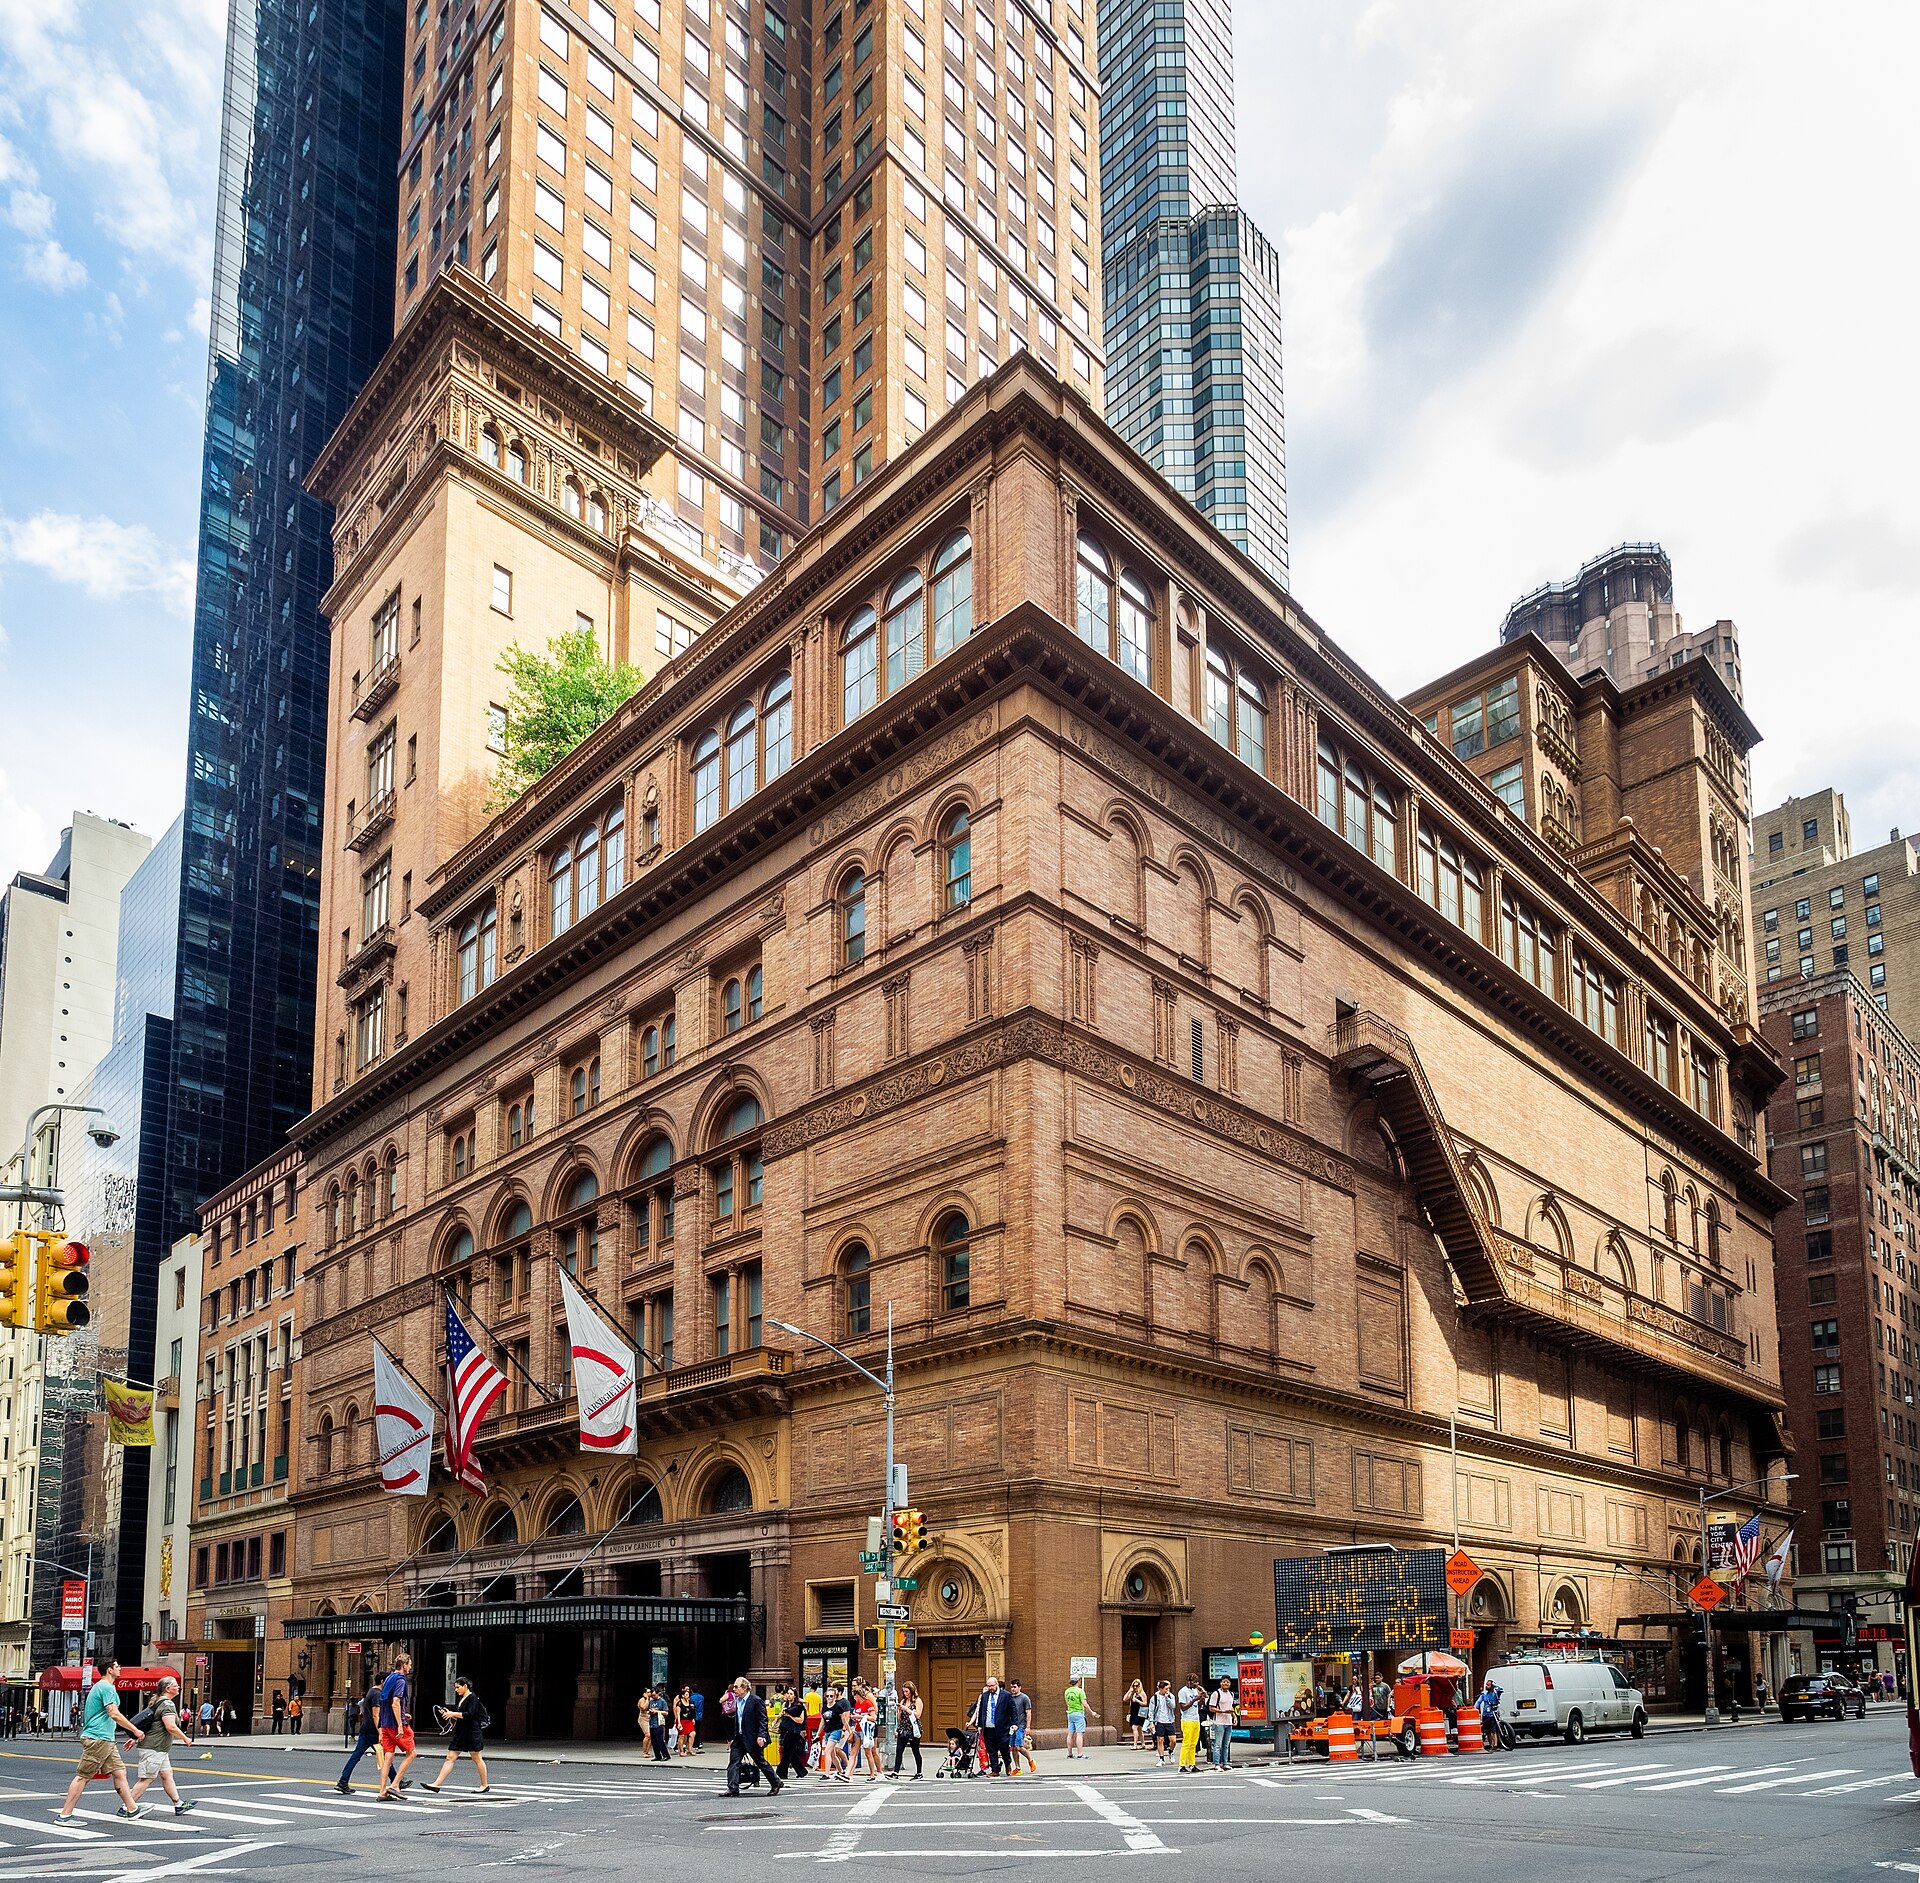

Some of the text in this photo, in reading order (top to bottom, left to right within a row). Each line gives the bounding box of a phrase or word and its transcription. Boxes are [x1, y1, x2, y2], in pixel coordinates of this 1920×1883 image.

[583, 1376, 631, 1416] CARNEGIE HALL
[380, 1429, 429, 1461] ARNEGIE HALL
[609, 1541, 661, 1553] ANDREW CARNEGIE
[904, 1580, 909, 1588] 7
[1305, 1554, 1409, 1585] SUNDAY
[1300, 1586, 1418, 1615] JUNE 30
[1284, 1615, 1438, 1647] S/B 7 AVE
[117, 1680, 133, 1688] TEA
